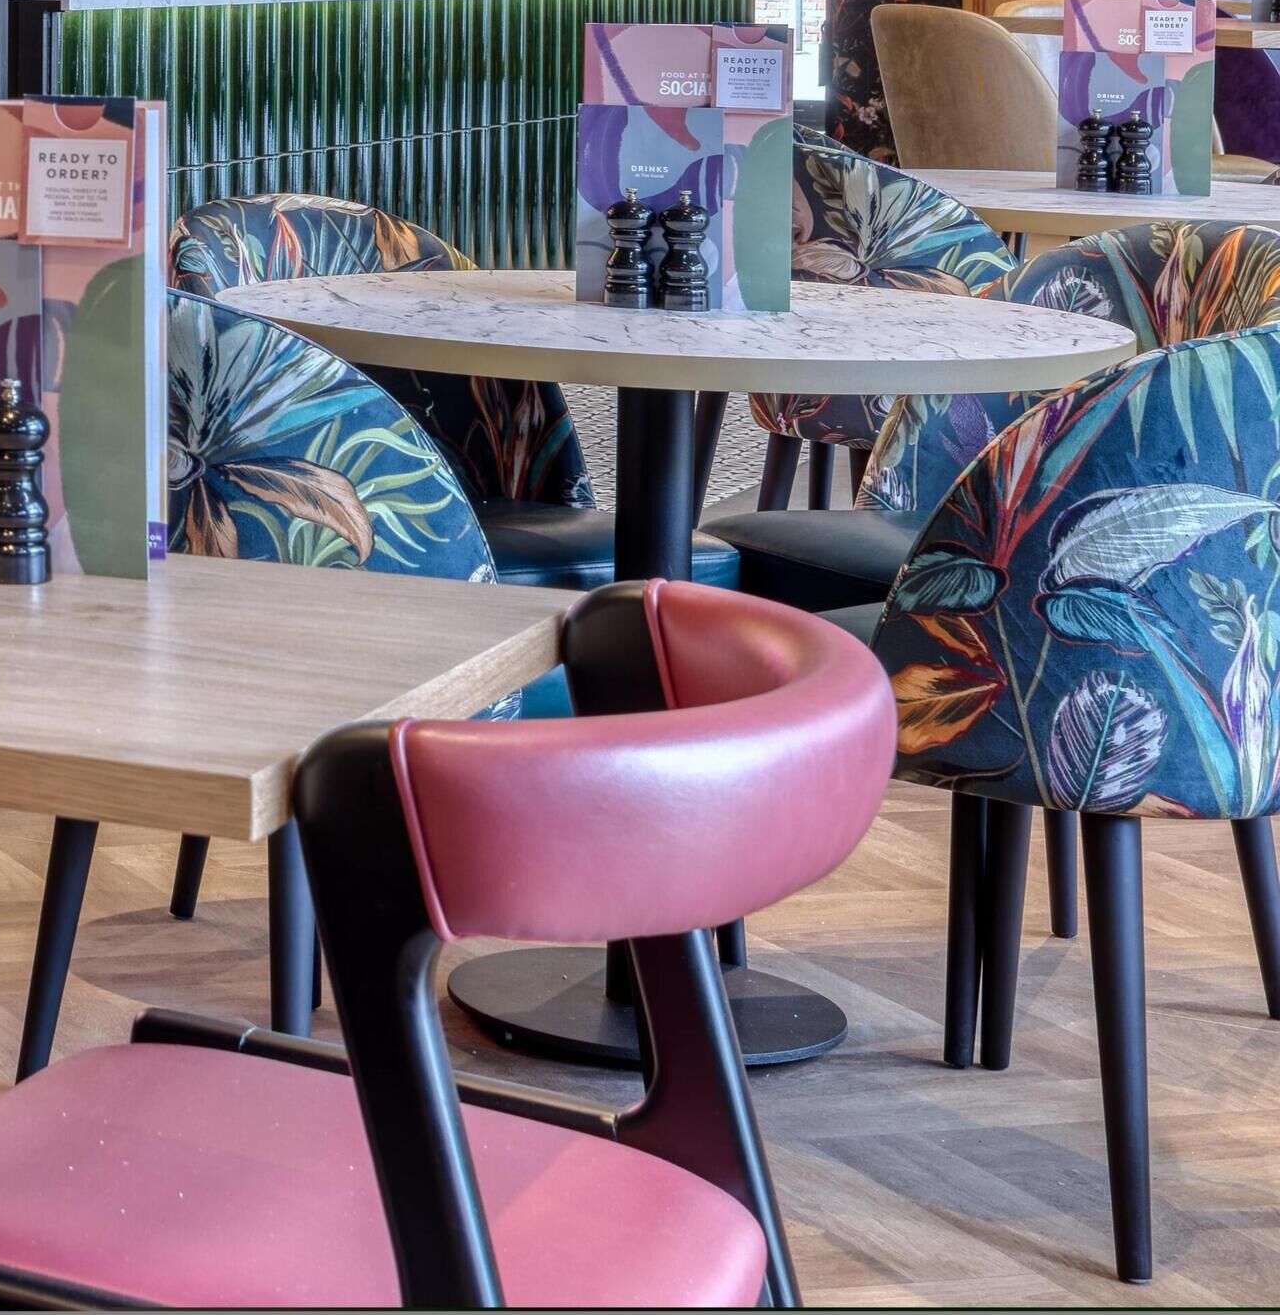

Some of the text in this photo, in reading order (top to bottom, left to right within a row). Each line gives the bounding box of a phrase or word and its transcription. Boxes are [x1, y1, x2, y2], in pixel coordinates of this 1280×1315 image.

[1117, 34, 1142, 46] SOC
[723, 57, 758, 65] READY
[661, 71, 686, 79] FOOD
[38, 152, 118, 165] READY TO
[46, 168, 109, 180] ORDER?
[631, 165, 669, 173] DRINKS
